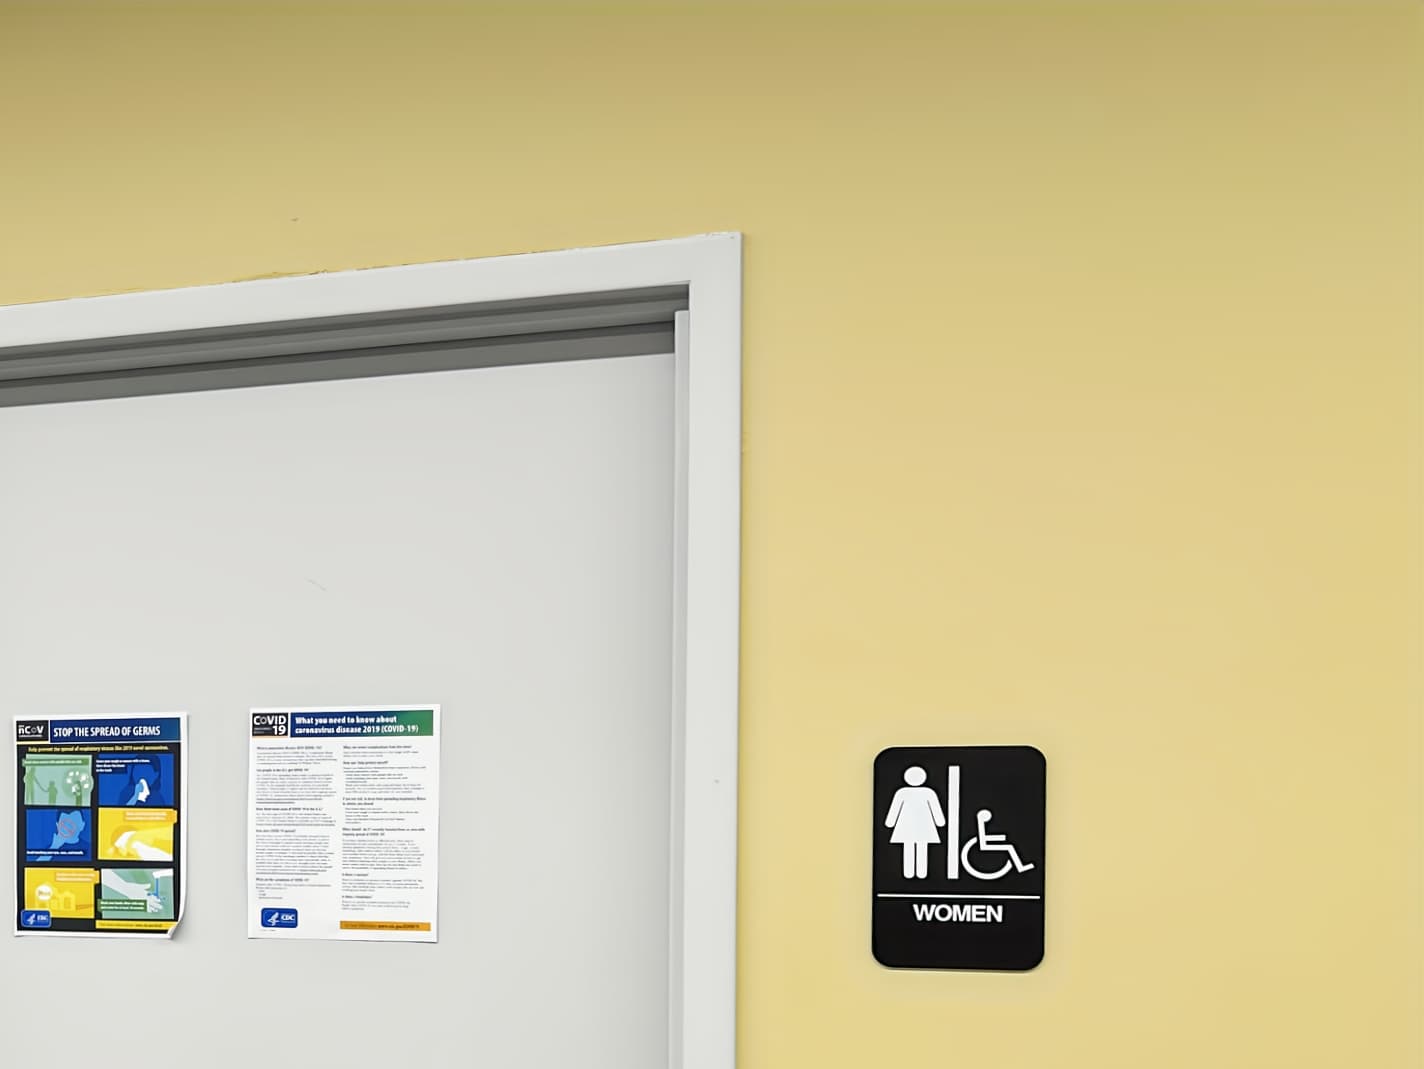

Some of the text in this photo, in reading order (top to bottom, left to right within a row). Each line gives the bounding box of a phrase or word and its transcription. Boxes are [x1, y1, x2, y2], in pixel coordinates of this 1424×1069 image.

[295, 714, 397, 726] What you need to know about
[53, 725, 161, 737] STOP THE SPREAD OF GERMS
[272, 725, 287, 735] 19
[295, 724, 419, 734] coronavirus disease 2019 (COVID-19)
[912, 903, 1004, 923] WOMEN
